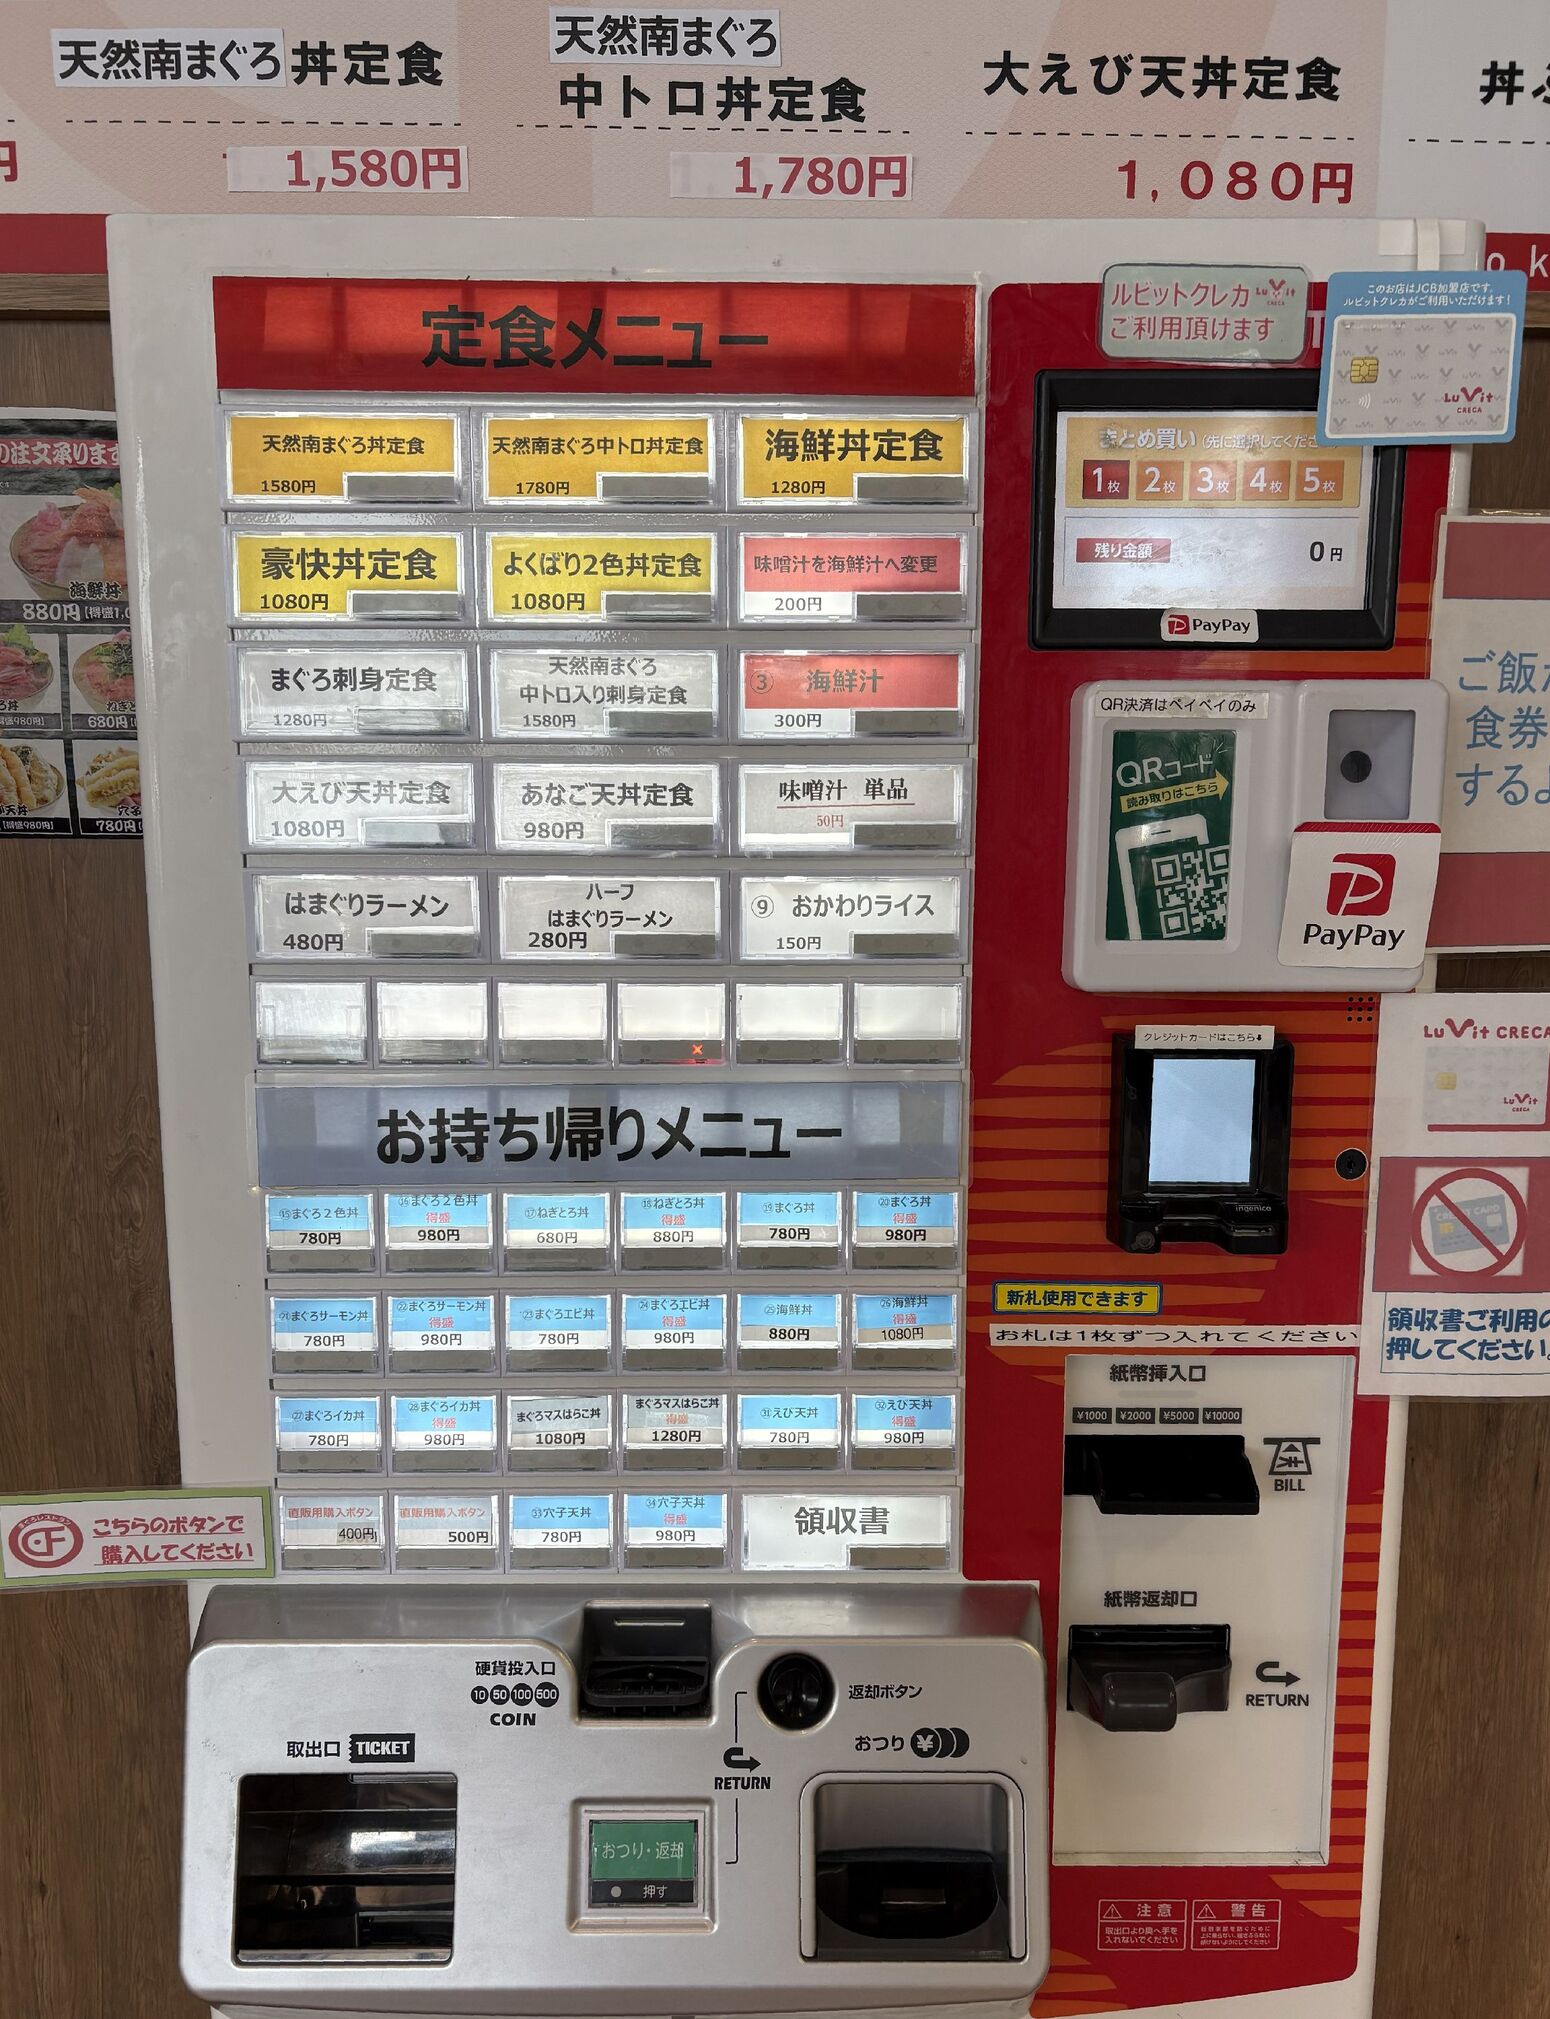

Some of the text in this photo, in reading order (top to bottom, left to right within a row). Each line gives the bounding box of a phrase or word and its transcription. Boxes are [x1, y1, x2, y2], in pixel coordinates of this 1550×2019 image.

[555, 14, 778, 58] 天然南まぐろ
[983, 50, 1342, 102] 大えび天丼定食
[559, 72, 867, 123] 中トロ丼定食
[286, 149, 463, 193] 1,580円
[734, 155, 907, 199] 1,780円
[1111, 281, 1250, 307] ルビットクレカ
[422, 304, 768, 369] 定食メニュー
[1111, 315, 1275, 342] ご利用頂けます
[262, 434, 425, 455] 天然南まぐろ丼定食
[492, 436, 703, 455] 天然南まぐろ中トロ丼定食
[765, 428, 943, 462] 海鮮丼定食
[1099, 427, 1322, 450] まとめ買い (先に選択してくださ
[260, 480, 316, 493] 1580円
[771, 481, 825, 495] 1280円
[1092, 467, 1121, 494] 1枚
[1144, 467, 1176, 494] 2枚
[1197, 467, 1229, 494] 3枚
[1250, 466, 1282, 493] 4枚
[1303, 466, 1335, 493] 5枚
[516, 482, 570, 495] 1780円
[1094, 542, 1153, 560] 残り金額
[261, 547, 437, 581] 豪快丼定食
[503, 551, 702, 578] よくばり2色丼定食
[754, 555, 938, 574] 味噌汁を海鮮汁へ変更
[69, 581, 122, 599] 海鮮丼
[260, 594, 329, 611] 1080円
[511, 593, 585, 611] 1080円
[775, 597, 822, 612] 200円
[22, 602, 81, 622] 880円
[1192, 619, 1250, 634] PayPay
[550, 656, 656, 676] 天然南まぐろ
[271, 667, 437, 692] まぐろ刺身定食
[750, 669, 884, 694] ③ 海鮮汁
[520, 684, 687, 706] 中トロ入り刺身定食
[1100, 697, 1257, 713] QR決済はペイペイのみ
[88, 715, 128, 729] 680円
[273, 713, 327, 727] 1280円
[522, 714, 576, 728] 1580円
[774, 713, 822, 728] 300円
[1115, 754, 1213, 788] QRコード
[271, 781, 450, 805] 大えび天丼定食
[521, 782, 694, 807] あなご天丼定食
[779, 777, 908, 802] 味噌汁 単品
[1126, 782, 1218, 808] 読み取りはこちら
[95, 820, 137, 832] 780円
[271, 820, 345, 838] 1080円
[816, 813, 844, 828] 50円
[523, 821, 584, 840] 980円
[586, 884, 634, 902] ハーフ
[285, 893, 449, 917] はまぐりラーメン
[751, 894, 935, 919] ⑨ おかわりライス
[548, 909, 673, 928] はまぐりラーメン
[282, 933, 344, 952] 480円
[528, 931, 587, 950] 280円
[776, 936, 822, 951] 150円
[1303, 923, 1406, 951] PayPay
[1144, 1032, 1256, 1042] クレジットカードはこちら
[1424, 1018, 1490, 1040] LuVit
[376, 1105, 842, 1165] お持ち帰りメニュー
[300, 1232, 341, 1245] 780円
[417, 1229, 460, 1242] 980円
[537, 1231, 578, 1244] 680円
[653, 1231, 694, 1243] 880円
[769, 1228, 810, 1240] 780円
[885, 1229, 926, 1242] 980円
[1006, 1289, 1149, 1307] 新札使用できます
[304, 1335, 345, 1347] 780円
[421, 1334, 462, 1346] 980円
[539, 1333, 579, 1345] 780円
[654, 1332, 694, 1344] 980円
[769, 1328, 810, 1341] 880円
[881, 1327, 924, 1340] 1080円
[995, 1328, 1358, 1344] お札は1枚ずつ入れてください
[1109, 1363, 1206, 1383] 紙幣挿入口
[635, 1397, 719, 1409] まぐろマスはらこ丼
[516, 1407, 601, 1422] まぐろマスはらこ丼
[1076, 1411, 1240, 1421] ¥1000 ¥2000 ¥5000 ¥10000
[308, 1434, 349, 1447] 780円
[424, 1434, 465, 1446] 980円
[535, 1432, 586, 1445] 1080円
[651, 1430, 702, 1443] 1280円
[769, 1431, 810, 1444] 780円
[884, 1431, 924, 1444] 980円
[1274, 1479, 1305, 1492] BILL
[92, 1515, 244, 1536] こちらのボタンで
[794, 1506, 890, 1535] 領収書
[338, 1527, 375, 1540] 400円
[448, 1531, 489, 1543] 500円
[541, 1531, 582, 1543] 780円
[655, 1530, 696, 1542] 980円
[101, 1542, 253, 1565] 購入してください
[1103, 1590, 1198, 1608] 紙幣返却口
[475, 1661, 556, 1676] 硬貨投入口
[474, 1688, 557, 1700] 10 50 100 500
[848, 1684, 923, 1700] 返却ボタン
[1246, 1694, 1309, 1707] RETURN
[490, 1713, 536, 1726] COIN
[287, 1740, 410, 1758] 取出口 TICKET
[854, 1734, 905, 1752] おつり
[714, 1777, 771, 1790] RETURN
[643, 1884, 668, 1898] 押す
[1137, 1903, 1172, 1917] 注意
[1231, 1903, 1266, 1917] 警告
[1105, 1936, 1179, 1945] 入れないでください
